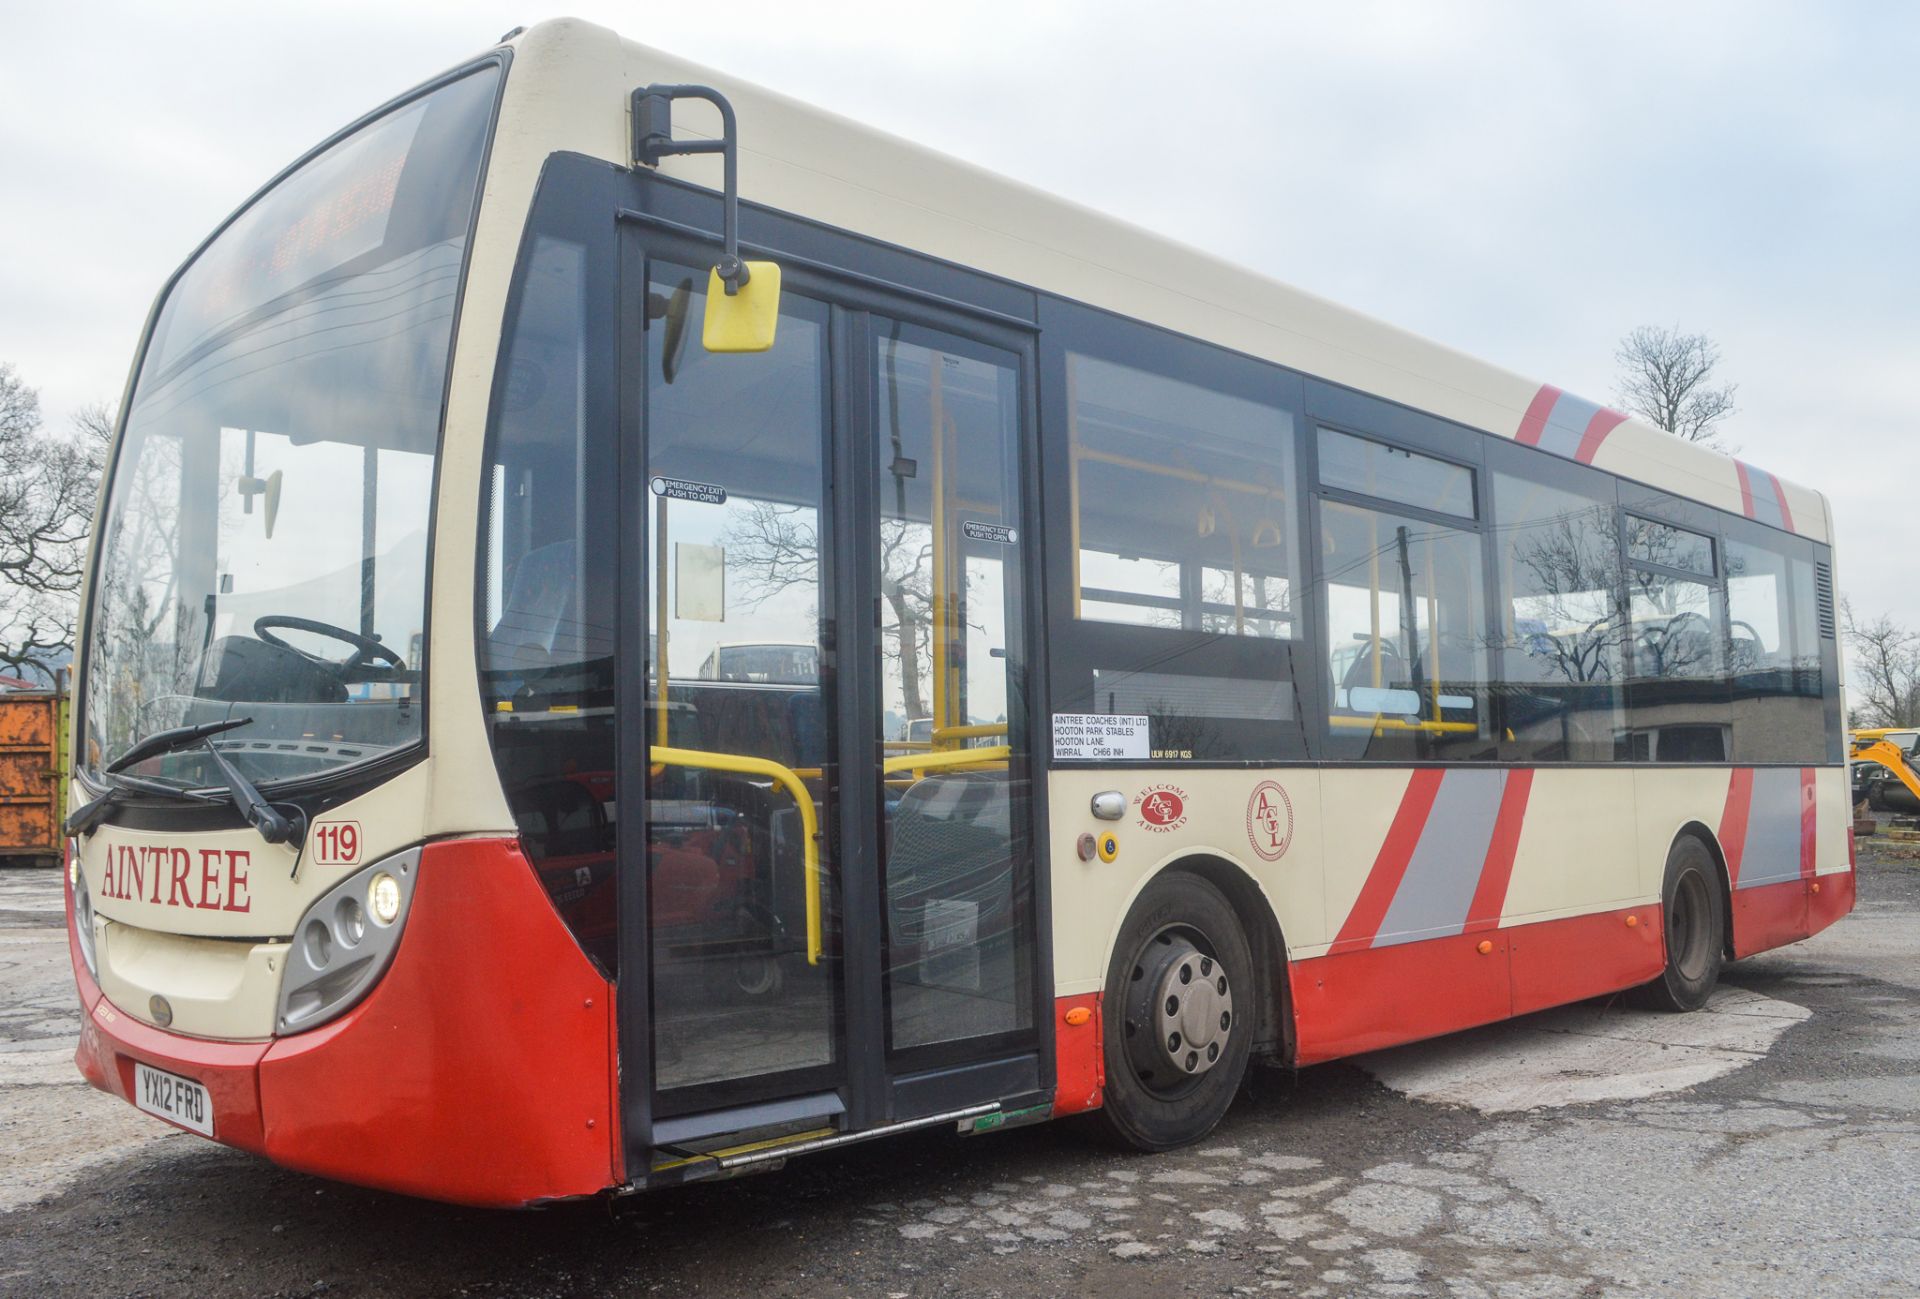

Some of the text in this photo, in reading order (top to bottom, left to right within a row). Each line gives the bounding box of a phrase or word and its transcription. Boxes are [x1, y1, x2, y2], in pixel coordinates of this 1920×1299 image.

[666, 481, 723, 495] EMERGENCY EXIT
[668, 489, 686, 497] PUSH
[699, 493, 718, 502] OPEN
[966, 523, 997, 532] EMERGENCY
[970, 530, 984, 538] PUSH
[1054, 716, 1147, 727] AINTREE COACHES (INT) LTD
[1054, 727, 1134, 736] HOOTON PARK STABLES
[1055, 737, 1104, 746] HOOTON LANE
[1056, 747, 1082, 756] WIRRAL
[1093, 747, 1111, 756] CH66
[1180, 750, 1192, 758] KGS
[1133, 784, 1189, 805] WELCOME
[1137, 816, 1188, 833] ABOARD
[316, 824, 358, 862] 119
[101, 844, 251, 913] AINTREE
[143, 1069, 204, 1124] YX12 FRD
